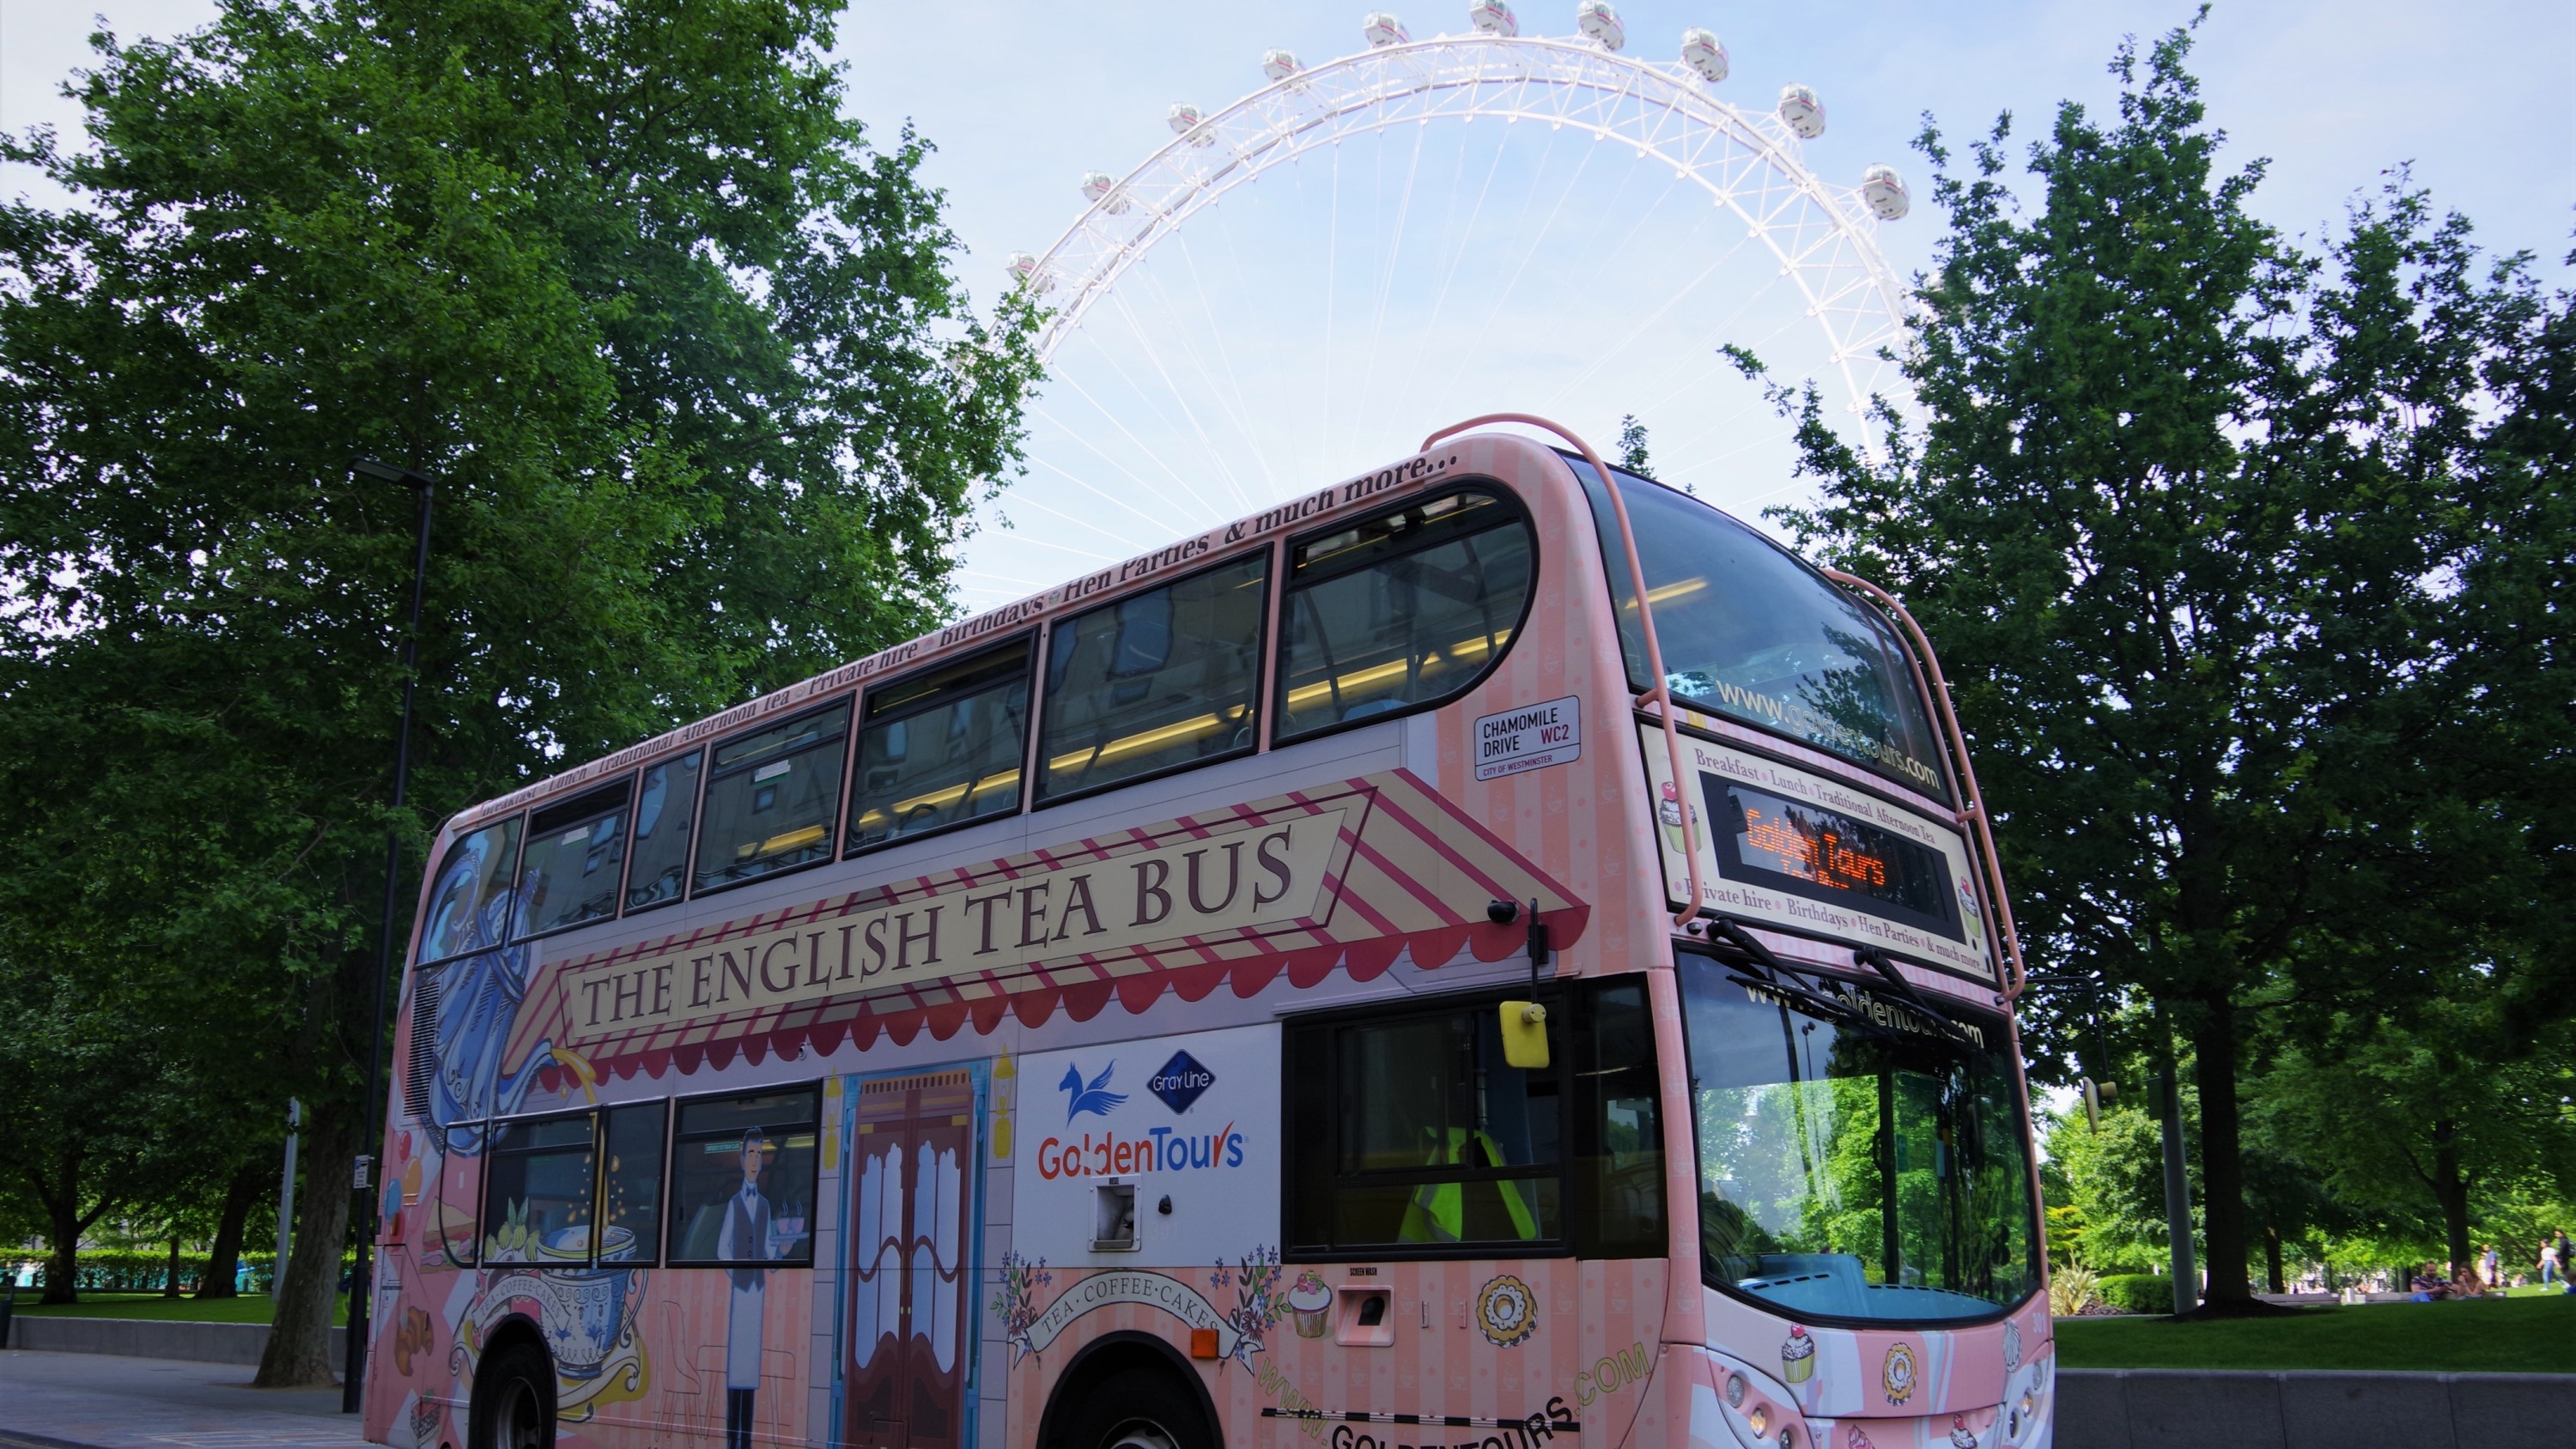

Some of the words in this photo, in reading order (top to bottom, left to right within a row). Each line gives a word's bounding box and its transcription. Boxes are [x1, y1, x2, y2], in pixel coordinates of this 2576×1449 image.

[808, 658, 875, 694] Private
[878, 641, 919, 670] hire
[939, 594, 1045, 648] Birthdays
[1063, 568, 1112, 603] Hen
[1119, 533, 1211, 584] Parties
[1224, 520, 1247, 545] &
[1255, 488, 1334, 535] much
[1483, 706, 1558, 739] CHAMOMILE
[1484, 734, 1520, 758] DRIVE
[1540, 724, 1569, 745] WC2
[1716, 679, 1941, 790] www.goldentours.com
[1483, 766, 1498, 777] CITY
[1498, 764, 1507, 773] OF
[1507, 754, 1553, 771] WESTMINSTER
[1693, 747, 1761, 781] Breakfast
[1769, 768, 1808, 796] Lunch
[1814, 783, 1874, 818] Traditional
[1876, 807, 1920, 837] Afternoon
[1918, 824, 1936, 845] Tea
[1746, 809, 1820, 866] Golden
[1824, 832, 1886, 887] Tours
[581, 960, 675, 1028] THE
[687, 905, 945, 1010] ENGLISH
[963, 873, 1108, 956] TEA
[1127, 823, 1292, 928] BUS
[1684, 877, 1741, 903] Pivate
[1741, 888, 1772, 911] hire
[1785, 897, 1850, 931] Birthdays
[1857, 915, 1883, 937] Hen
[1882, 922, 1920, 948] Parties
[1926, 936, 1935, 953] &
[1936, 944, 1960, 962] much
[480, 1294, 496, 1317] TEA
[500, 1278, 533, 1296] COFFEE
[535, 1284, 561, 1319] CAKES
[1042, 1300, 1074, 1334] TEA
[1084, 1277, 1153, 1303] COFFEE
